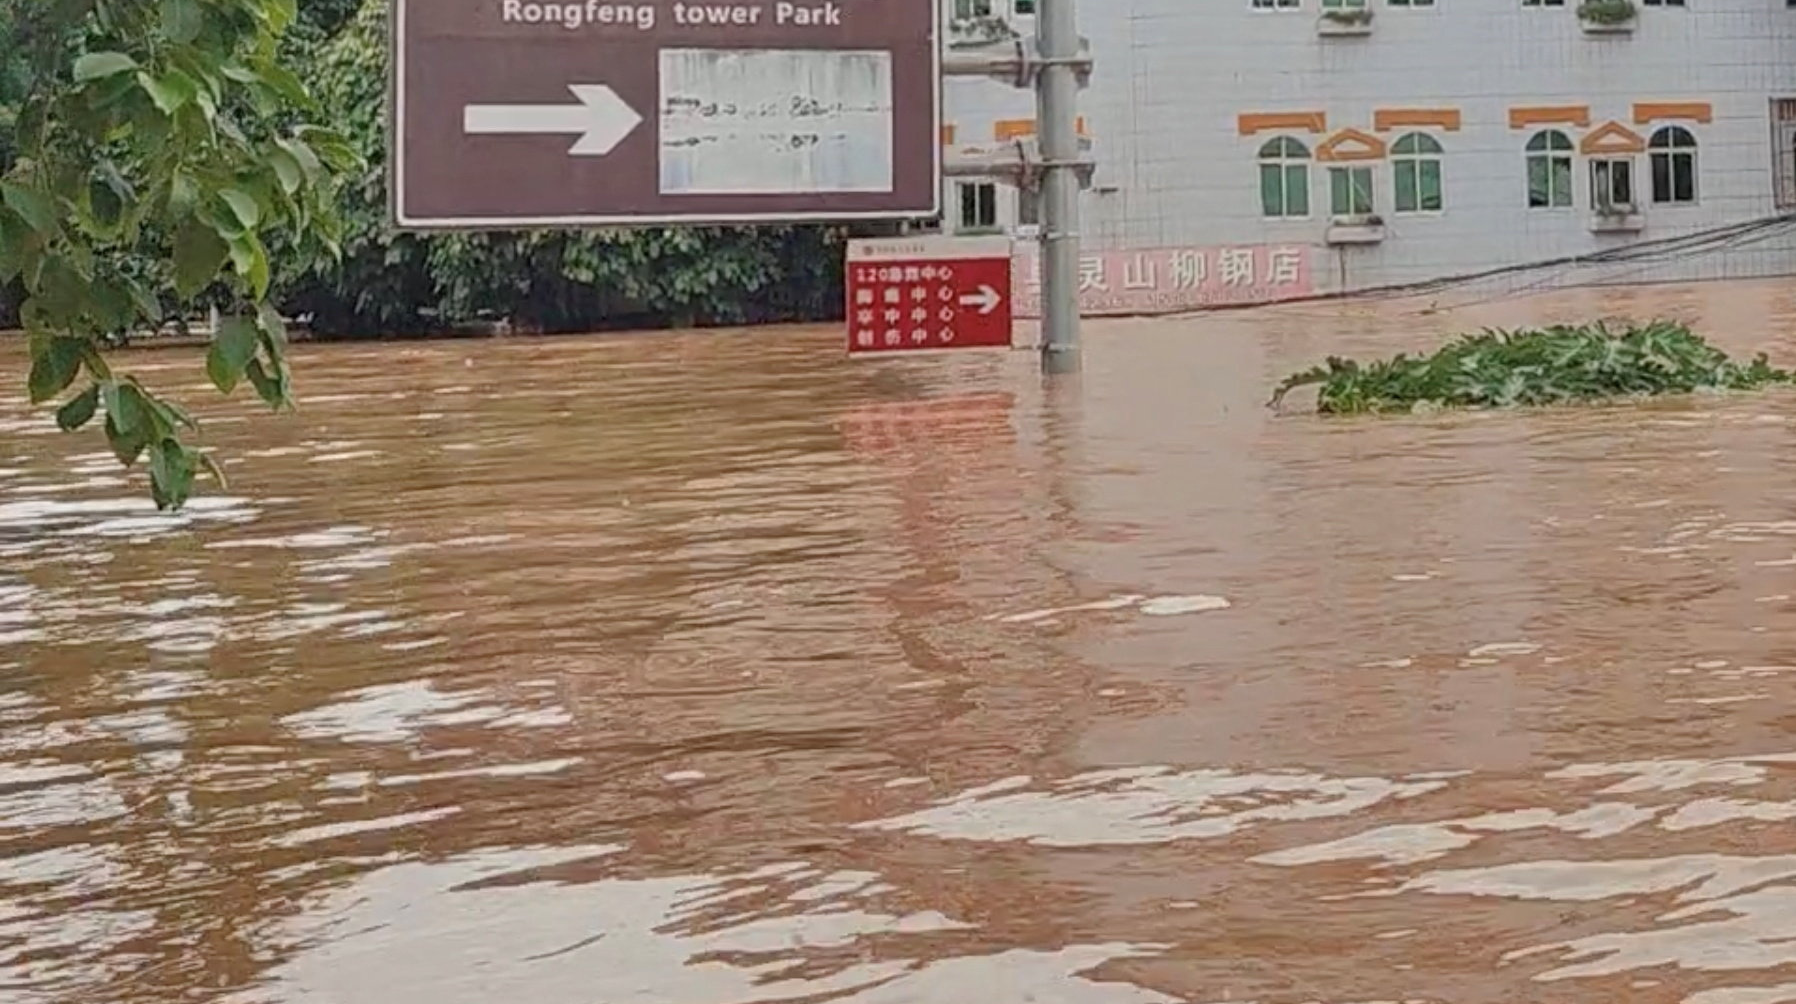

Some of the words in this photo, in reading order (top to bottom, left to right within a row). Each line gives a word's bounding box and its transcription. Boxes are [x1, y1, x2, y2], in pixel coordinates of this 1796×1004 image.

[503, 0, 655, 30] Rongfeng
[675, 3, 761, 25] tower
[776, 2, 841, 25] Park
[1027, 247, 1300, 292] 灵山柳钢店
